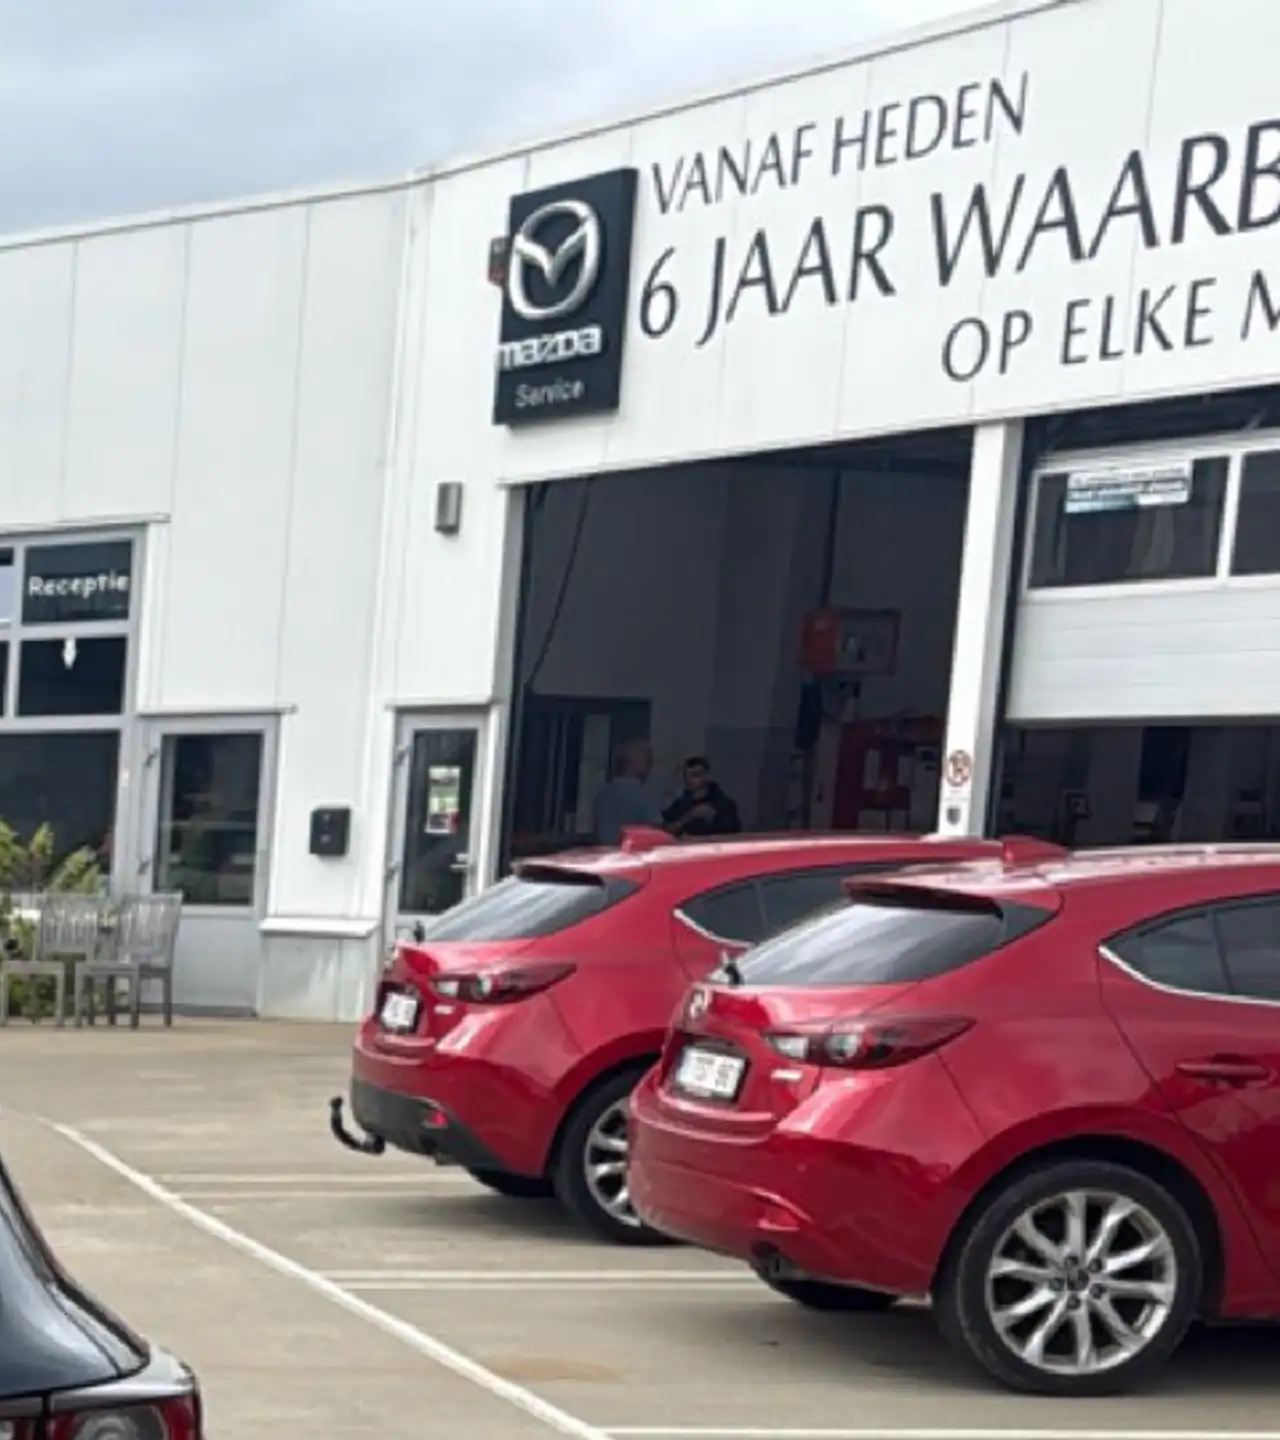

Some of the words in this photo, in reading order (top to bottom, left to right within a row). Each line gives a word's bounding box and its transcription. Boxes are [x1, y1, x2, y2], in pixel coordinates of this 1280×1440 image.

[651, 120, 818, 215] VANAF
[830, 69, 1030, 177] HEDEN
[639, 245, 679, 340] 6
[694, 203, 898, 350] JAAR
[929, 117, 1280, 288] WAARB
[941, 308, 1034, 383] OP
[1059, 276, 1218, 366] ELKE
[514, 377, 586, 408] Service
[28, 568, 130, 599] Receptie
